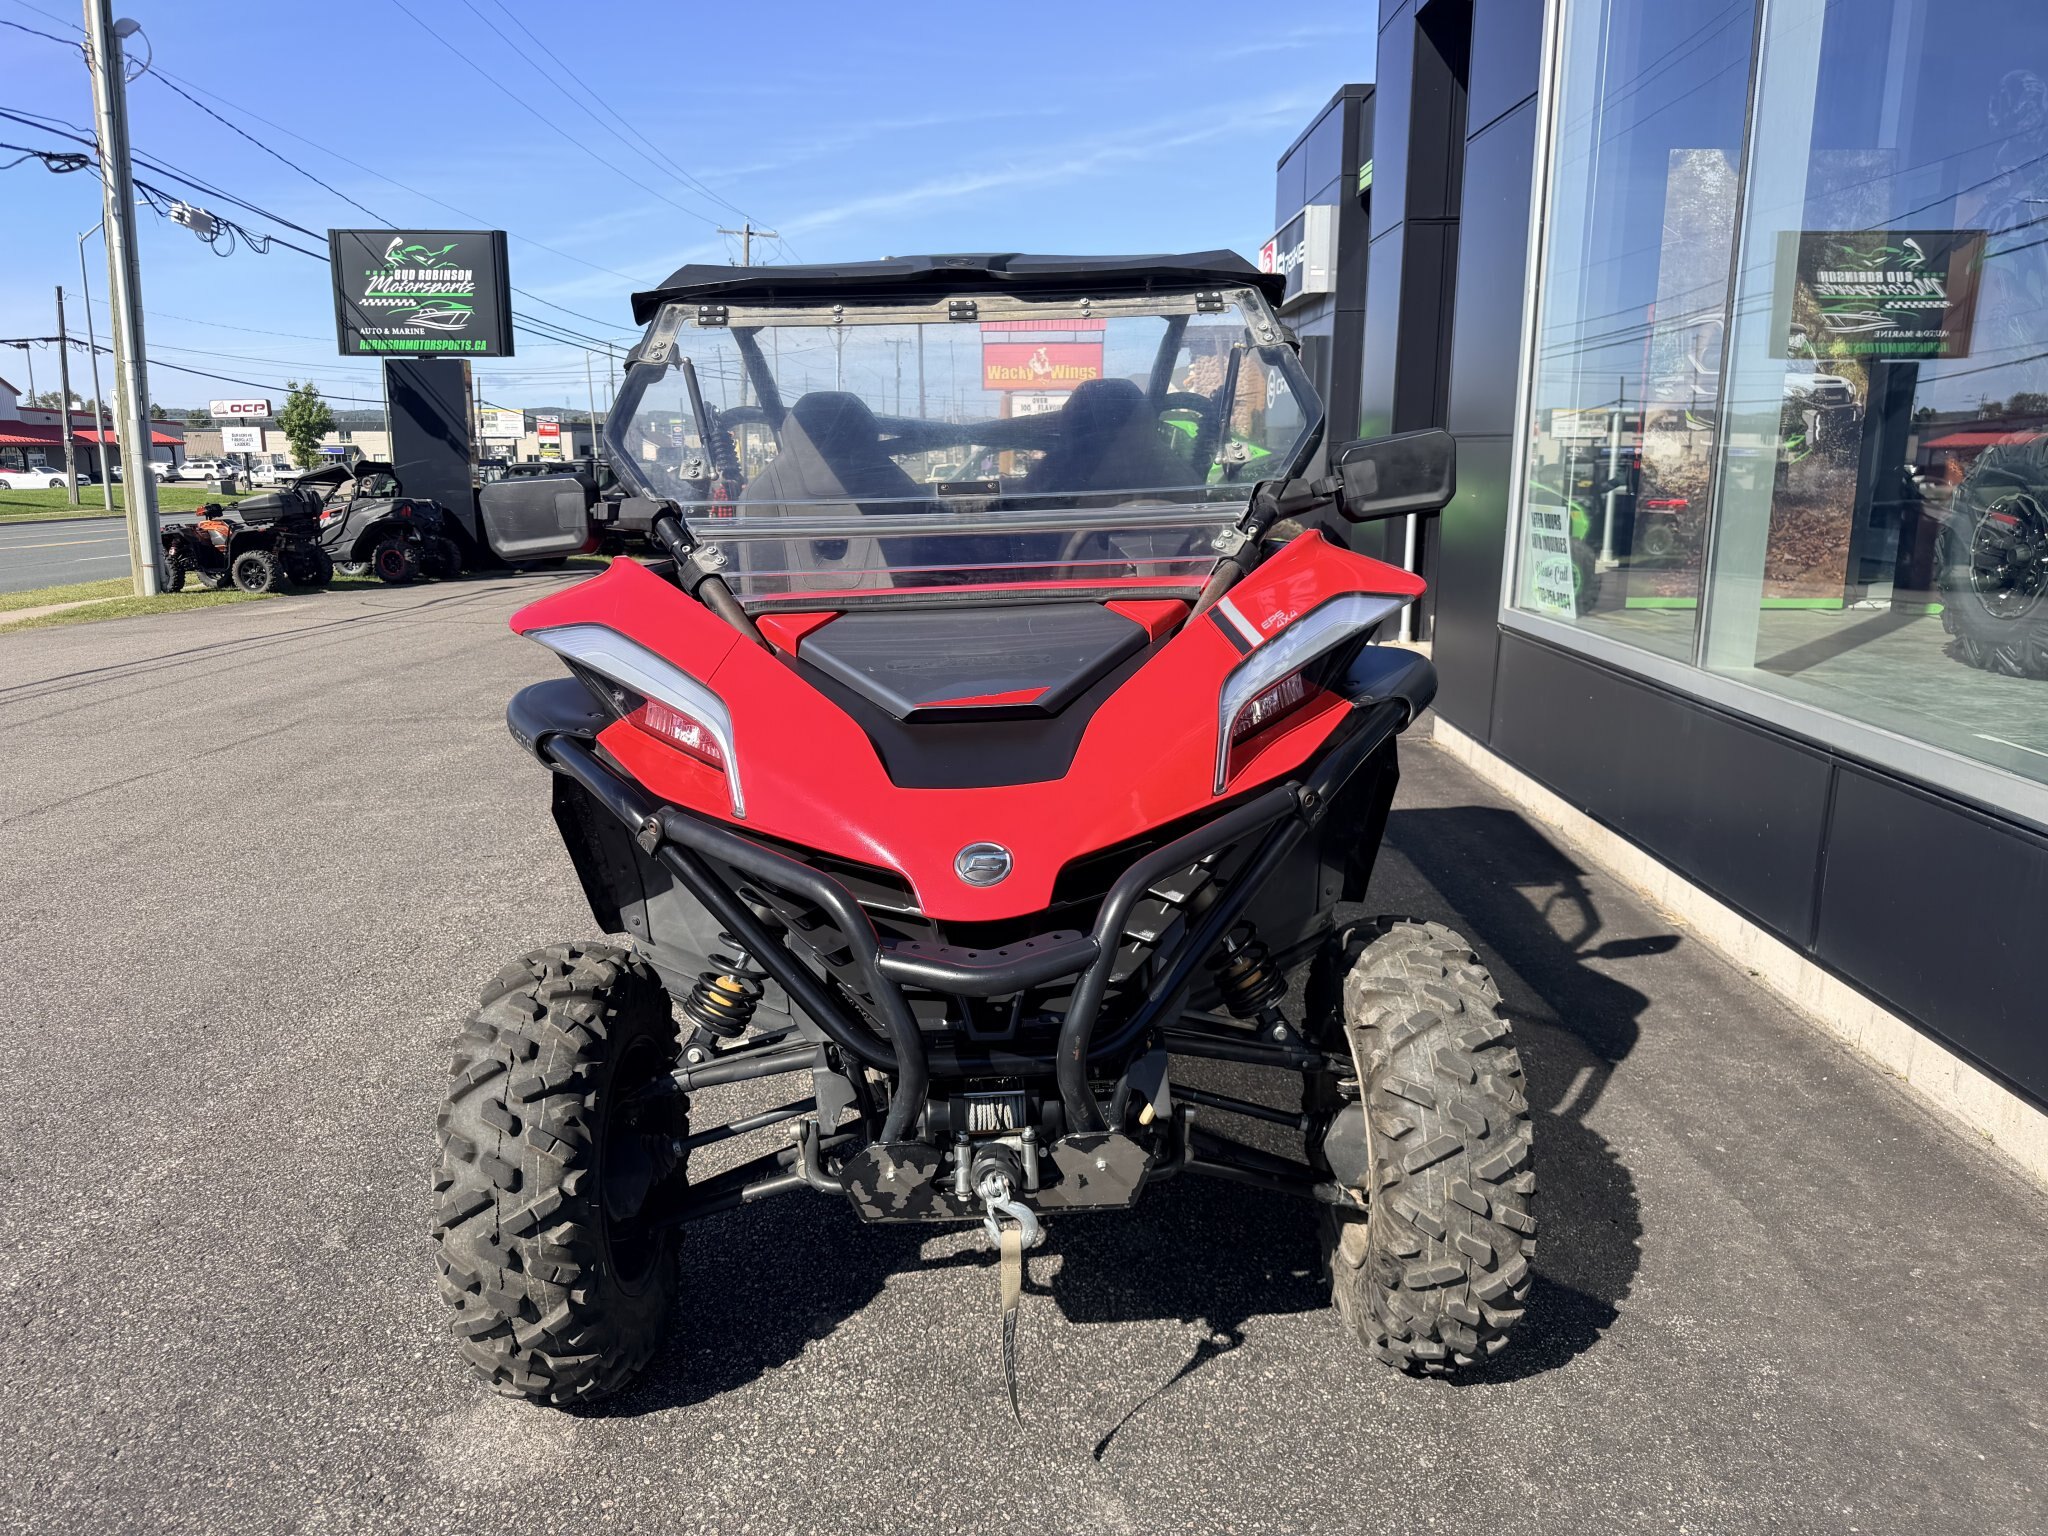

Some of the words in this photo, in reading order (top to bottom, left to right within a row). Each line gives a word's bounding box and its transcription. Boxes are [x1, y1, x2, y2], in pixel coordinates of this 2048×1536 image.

[394, 269, 416, 281] BUD
[418, 269, 473, 281] ROBINSON
[364, 275, 476, 297] Motorsports
[360, 327, 383, 335] AUTO
[383, 327, 390, 335] &
[391, 327, 426, 335] MARINE
[360, 339, 487, 351] ROBINSONMOTORSPORTS.CA
[988, 365, 1034, 380] Wacky
[1051, 364, 1096, 379] Wings
[230, 404, 265, 412] OCP
[1554, 565, 1569, 585] Call
[1261, 609, 1285, 630] EPS
